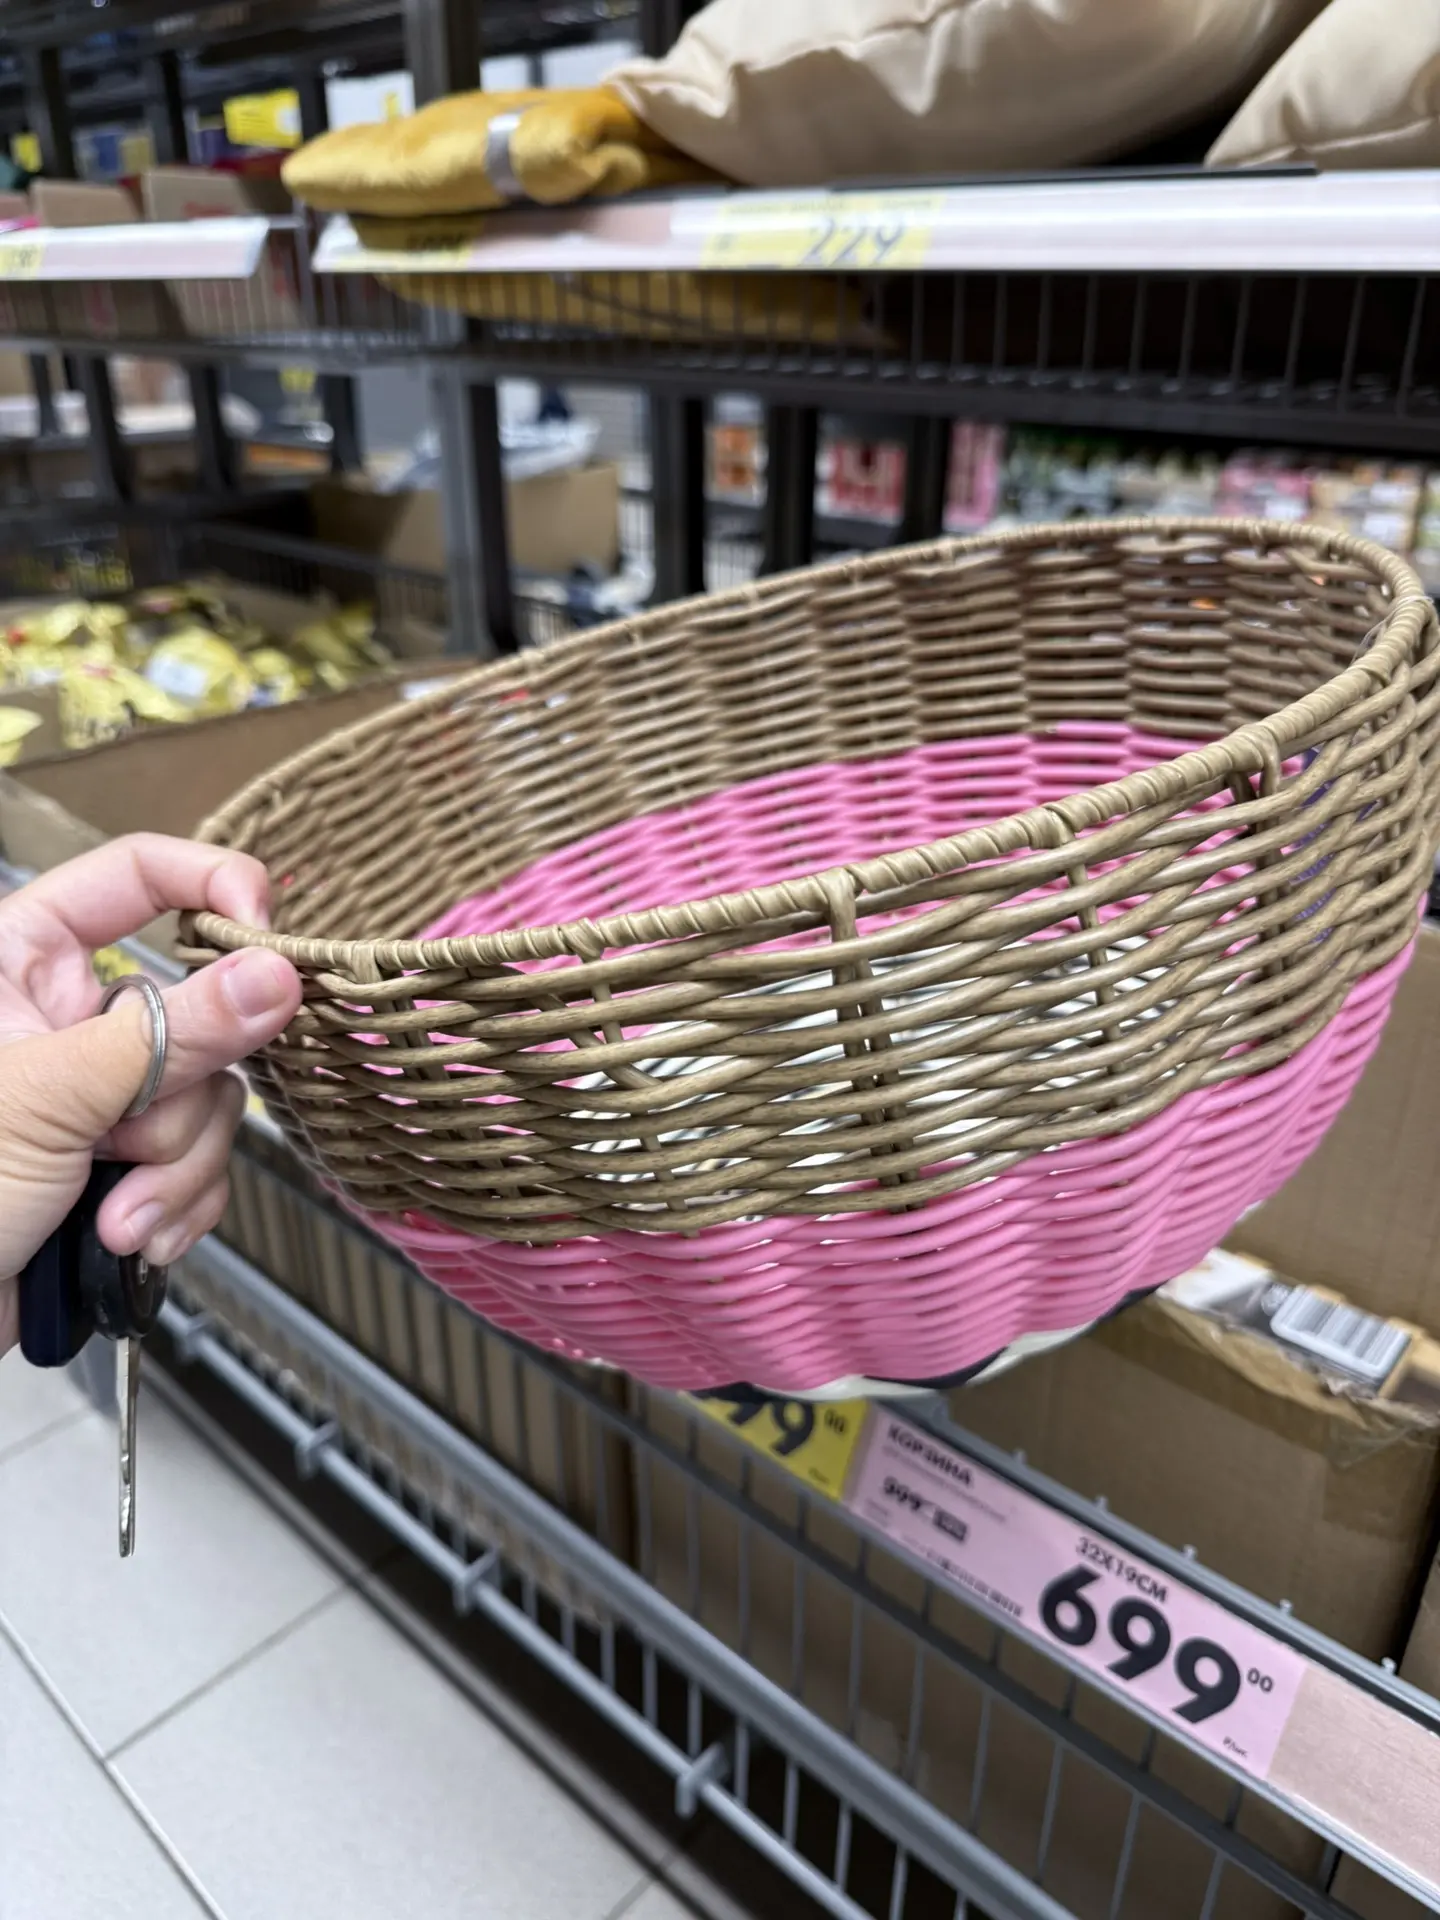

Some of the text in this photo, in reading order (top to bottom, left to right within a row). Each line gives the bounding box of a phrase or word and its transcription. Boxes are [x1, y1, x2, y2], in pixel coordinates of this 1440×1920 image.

[888, 1423, 974, 1487] КОРЗИНА
[1039, 1563, 1241, 1724] 699
[1246, 1667, 1274, 1693] 00
